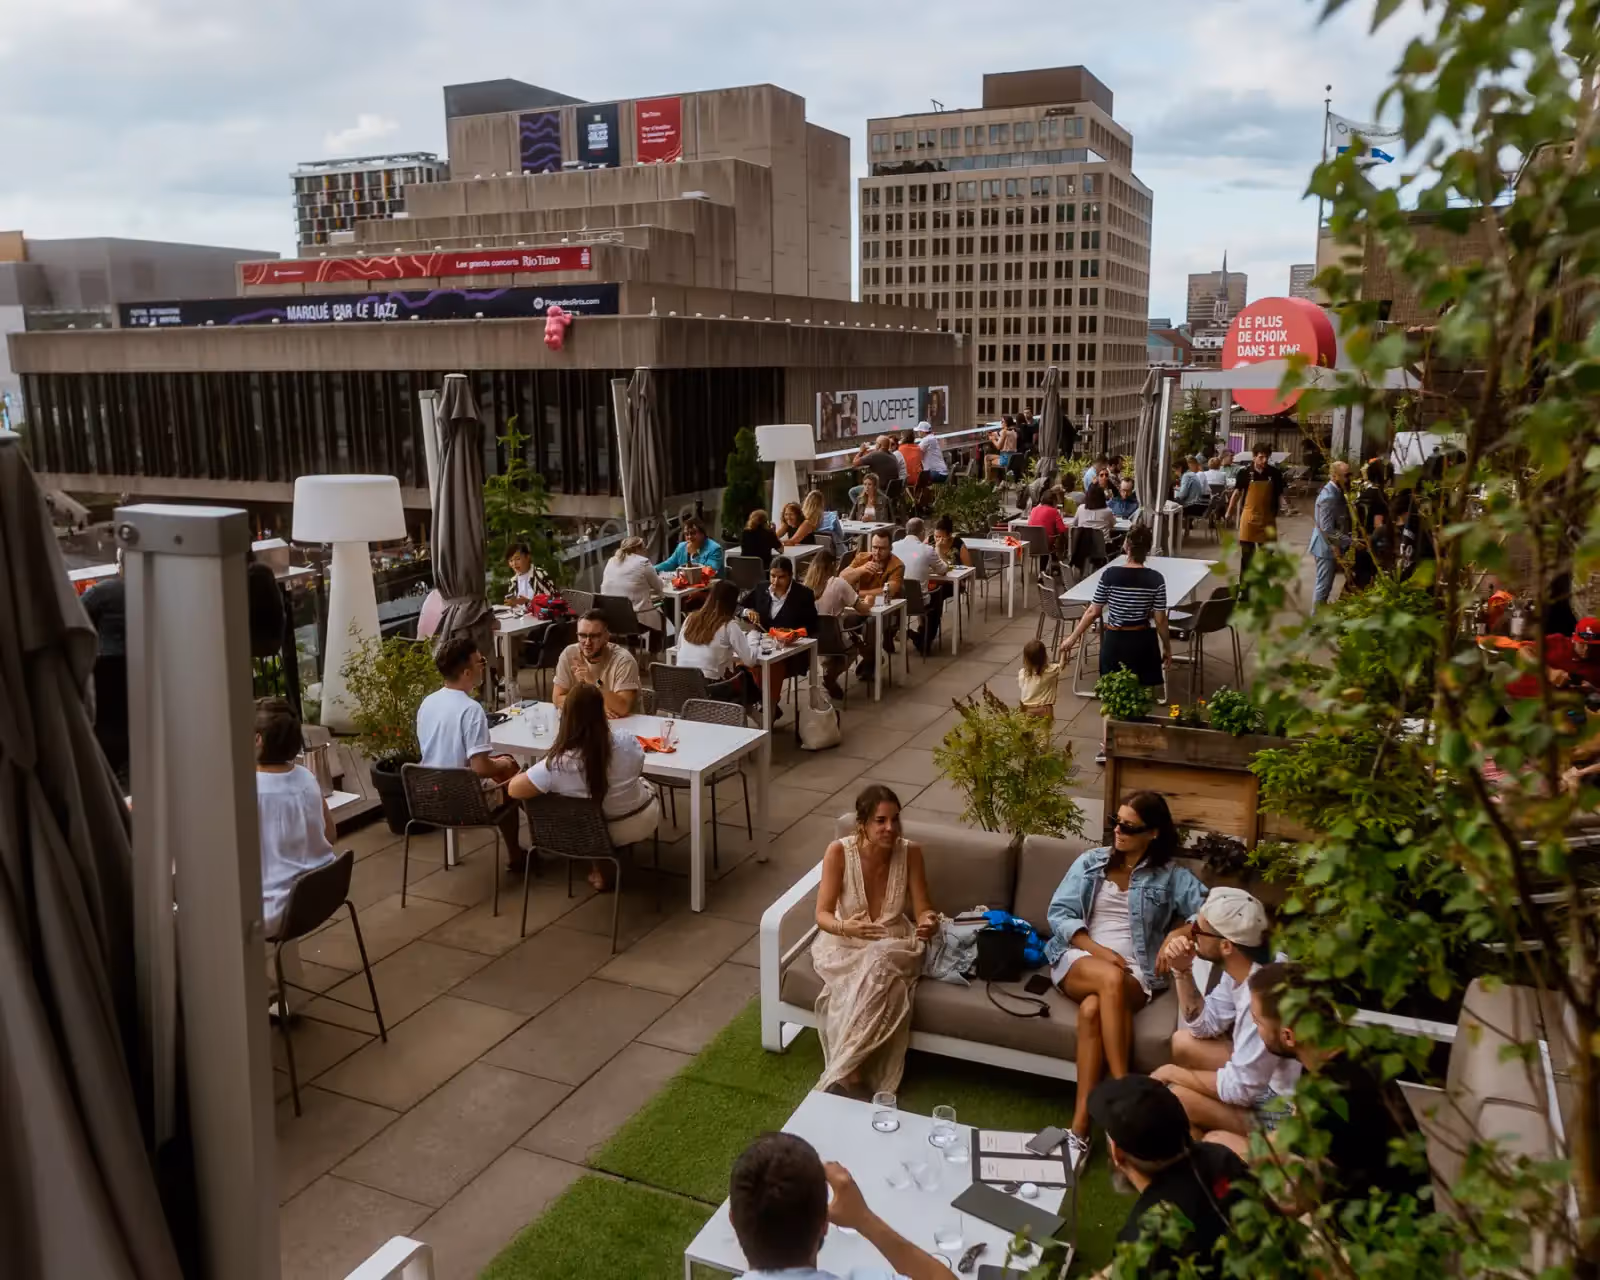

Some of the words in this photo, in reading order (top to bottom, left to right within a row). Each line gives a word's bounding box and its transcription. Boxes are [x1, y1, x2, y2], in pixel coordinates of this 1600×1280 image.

[469, 260, 490, 269] grands
[491, 259, 519, 267] concerts
[287, 302, 329, 320] MARQUÉ
[332, 304, 353, 319] PAR
[356, 303, 369, 318] LE
[373, 302, 398, 318] JAZZ
[1239, 316, 1252, 328] LE
[1255, 315, 1283, 328] PLUS
[1238, 331, 1252, 343] DE
[1255, 330, 1288, 342] CHOIX
[1237, 344, 1266, 357] DANS
[1268, 344, 1276, 356] 1
[862, 398, 915, 423] DUCEPPE
